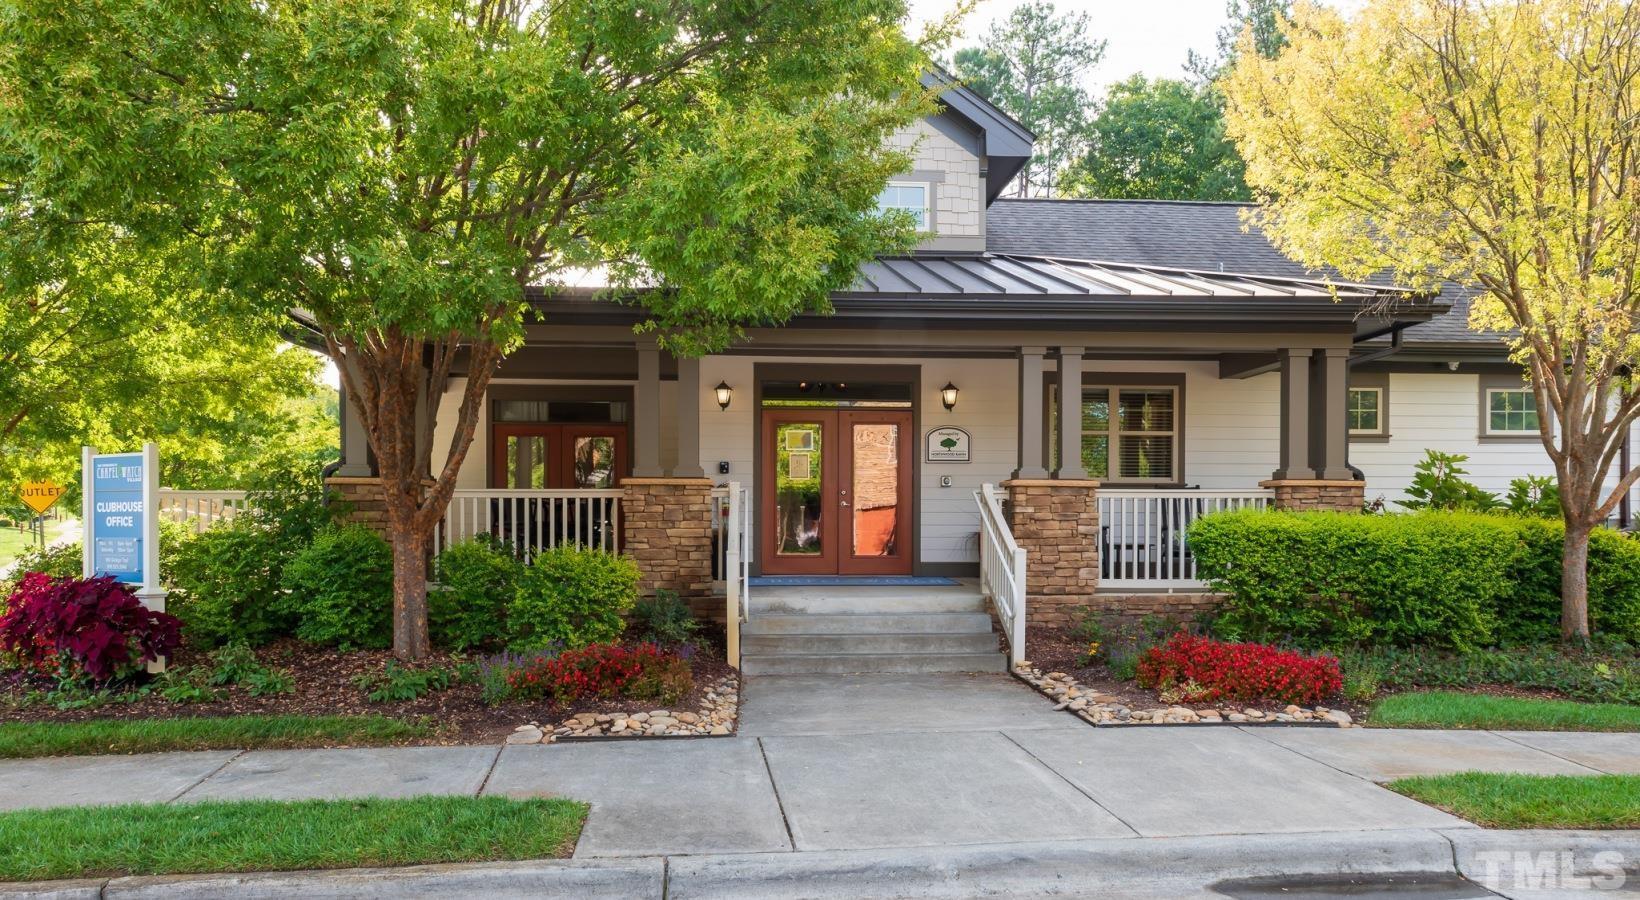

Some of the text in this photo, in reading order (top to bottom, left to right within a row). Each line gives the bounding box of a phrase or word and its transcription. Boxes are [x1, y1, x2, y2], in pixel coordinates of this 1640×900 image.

[96, 466, 142, 479] CHAPEL WATCH
[96, 501, 143, 513] CLUBHOUSE
[106, 516, 134, 527] OFFICE
